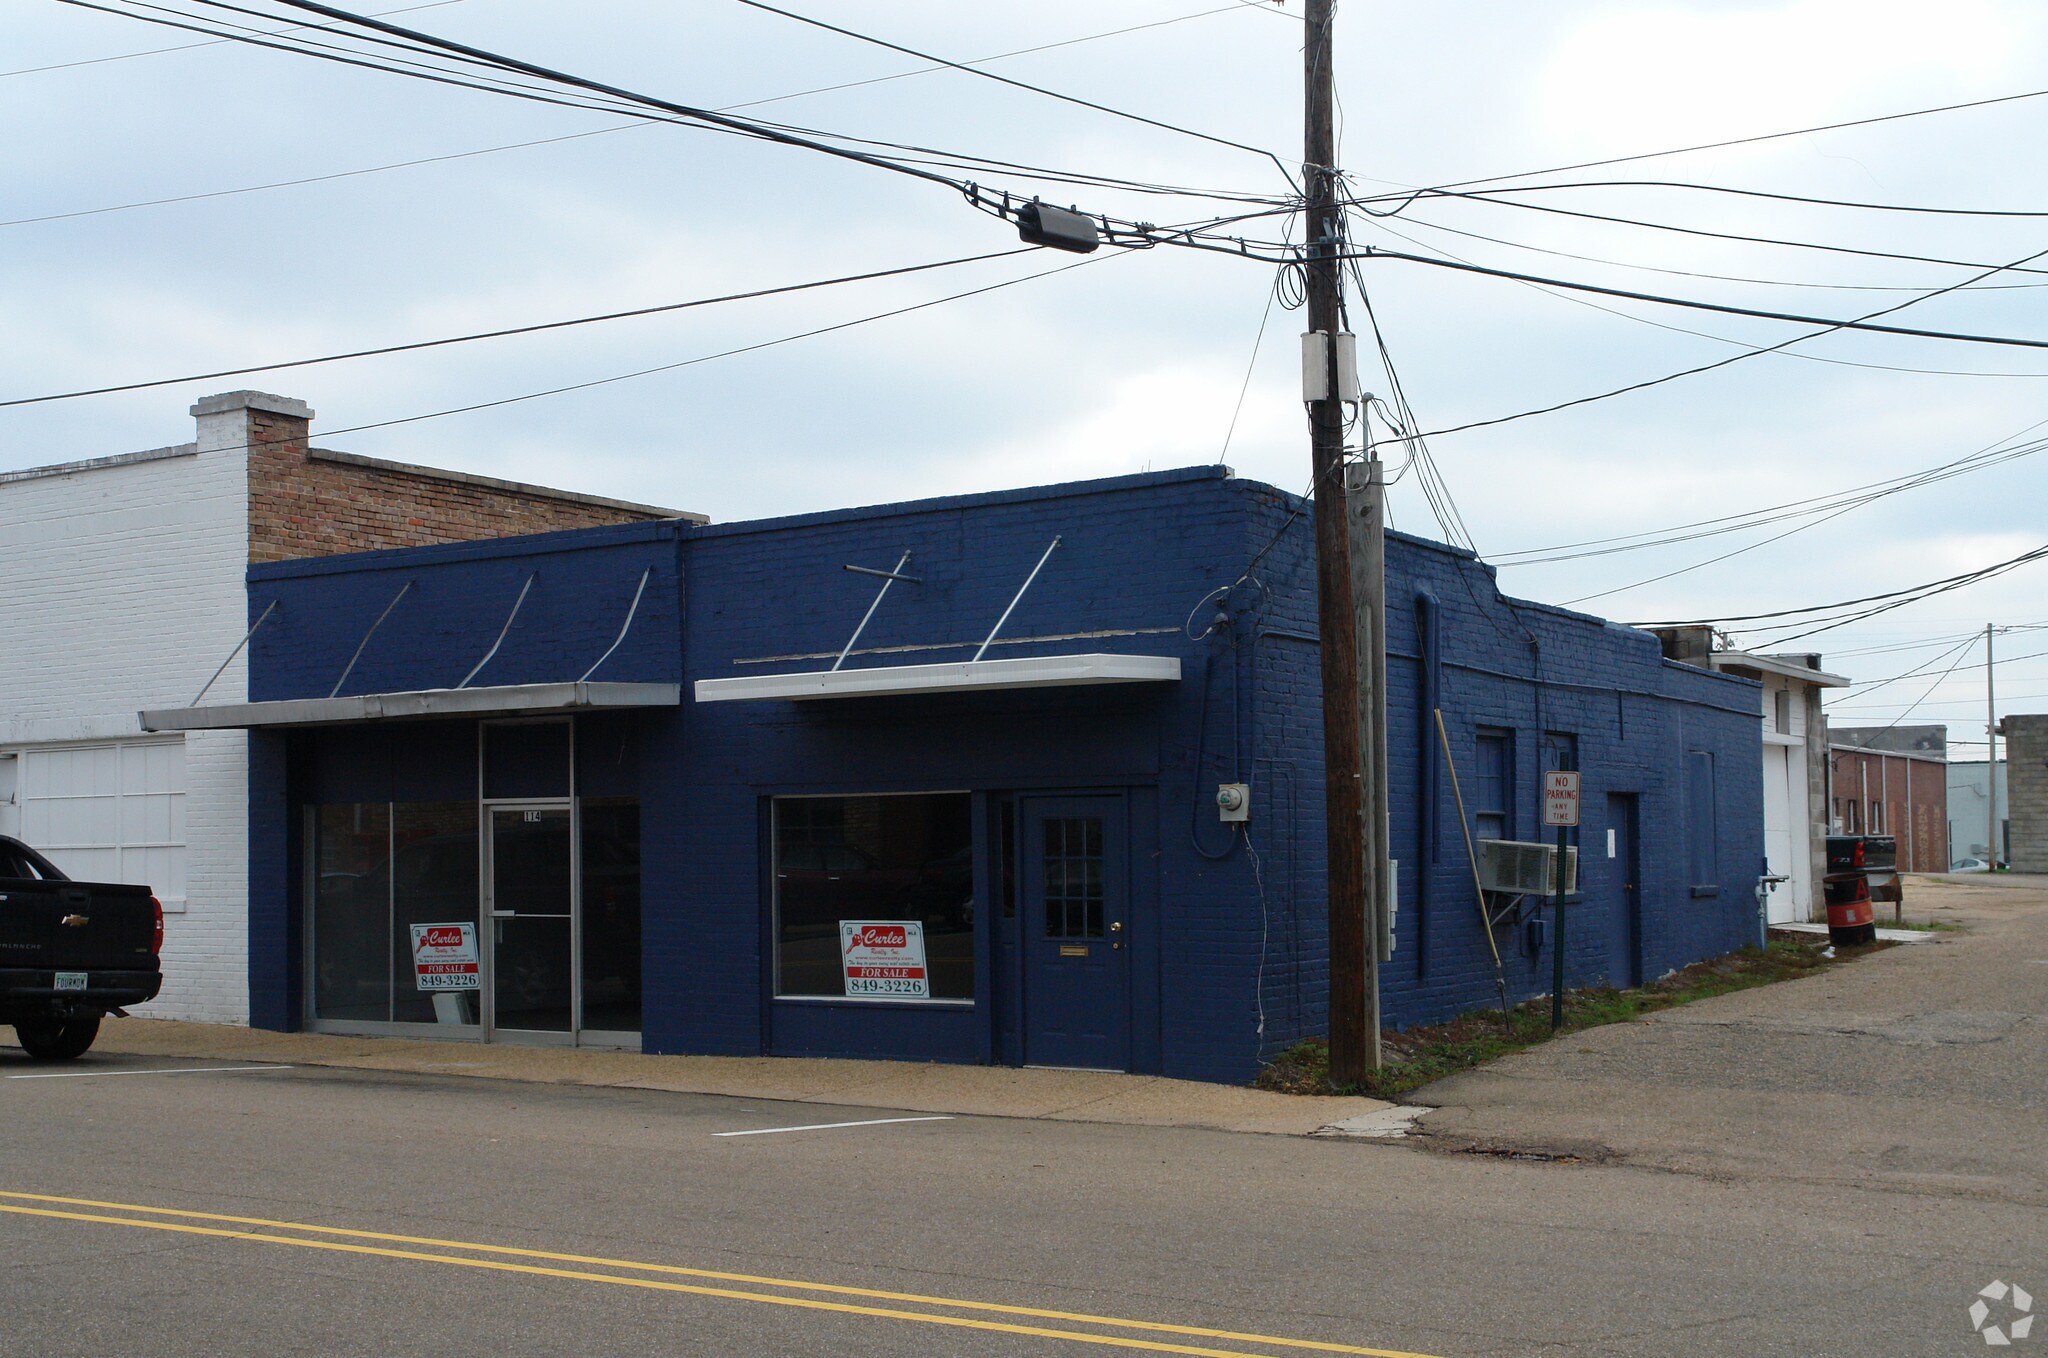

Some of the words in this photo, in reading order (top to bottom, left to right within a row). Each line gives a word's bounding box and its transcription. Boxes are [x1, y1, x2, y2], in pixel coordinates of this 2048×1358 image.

[1555, 777, 1568, 787] NO
[1547, 790, 1576, 800] PARKING
[526, 812, 540, 820] 114
[430, 931, 460, 944] Curlee
[864, 929, 904, 944] Curlee
[428, 965, 443, 973] FOR
[444, 964, 466, 972] SALE
[860, 968, 880, 977] FOR
[882, 968, 908, 977] SALE
[421, 975, 476, 986] 849-3226
[851, 979, 922, 992] 849-3226
